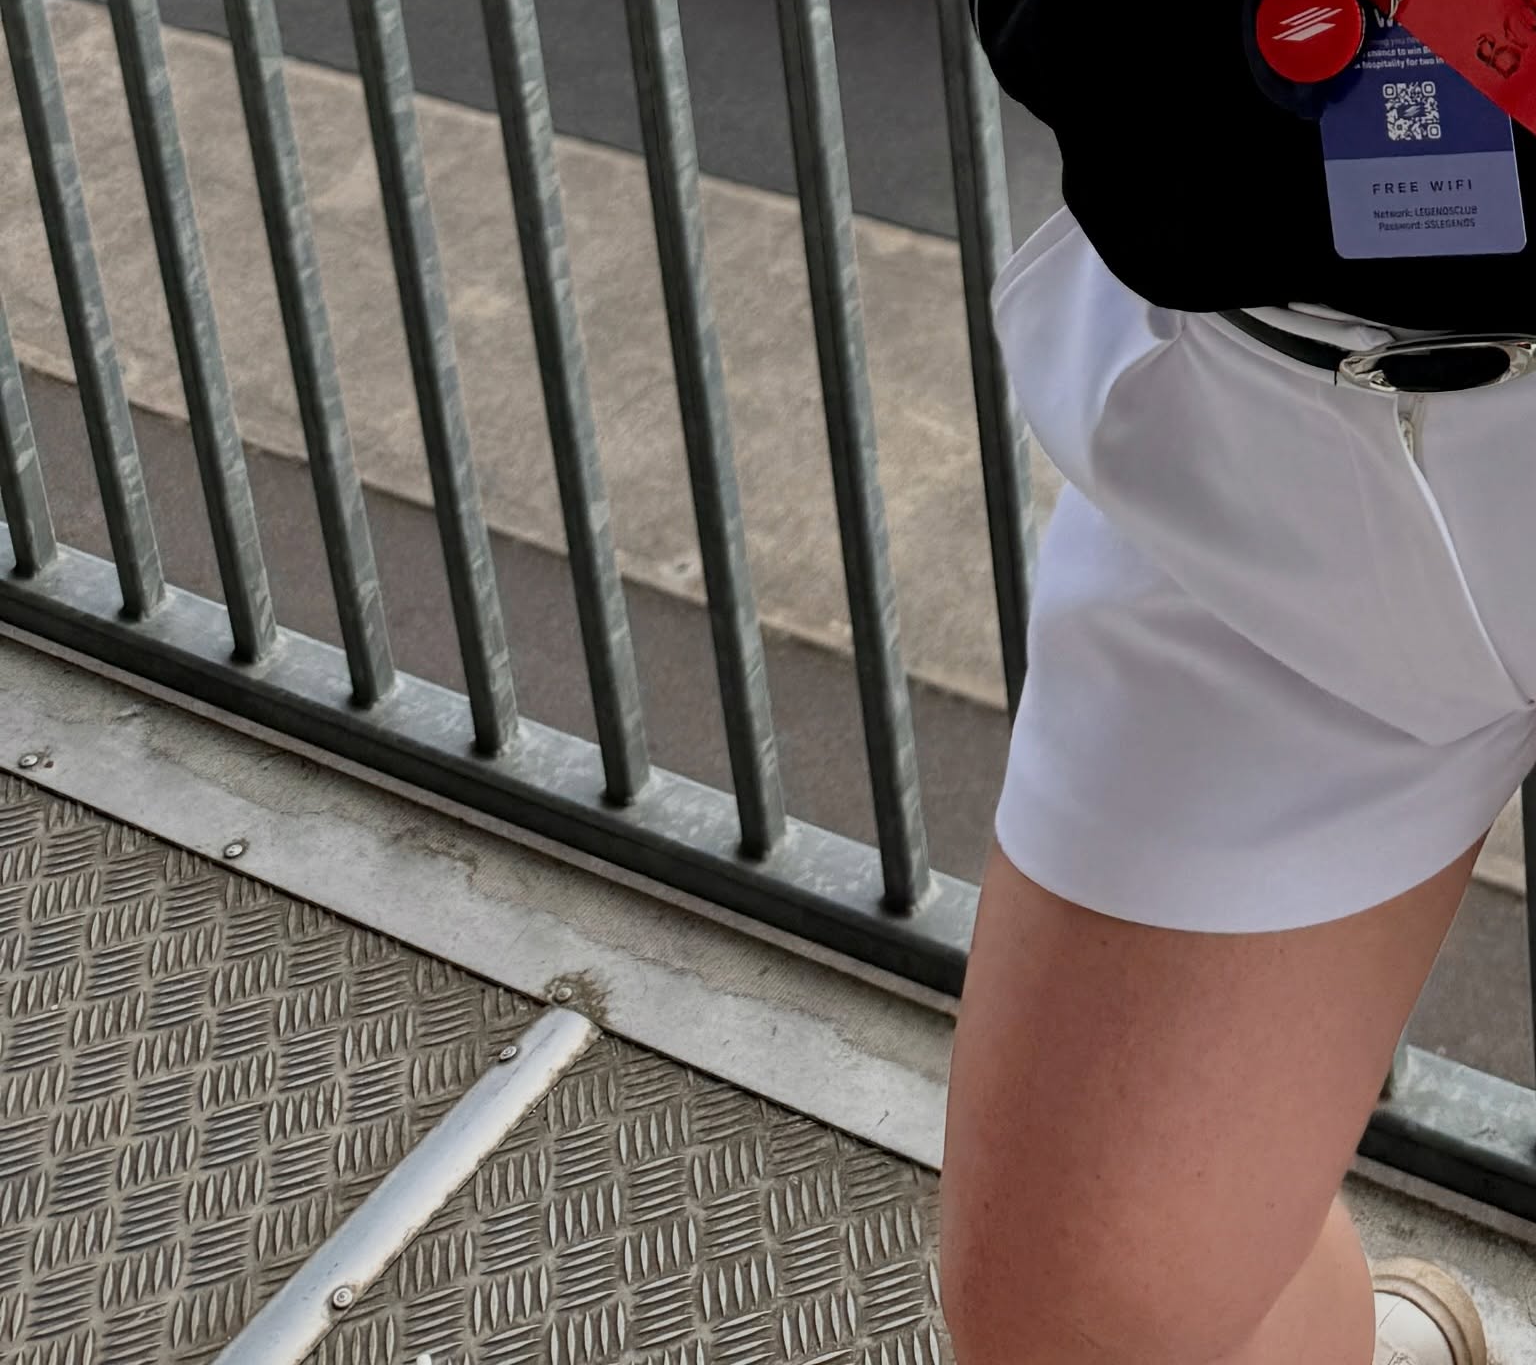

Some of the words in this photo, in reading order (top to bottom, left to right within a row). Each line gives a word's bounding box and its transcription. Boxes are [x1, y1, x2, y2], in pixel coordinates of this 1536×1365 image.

[1406, 57, 1418, 66] for
[1372, 181, 1419, 195] FREE
[1430, 178, 1472, 192] WIFI
